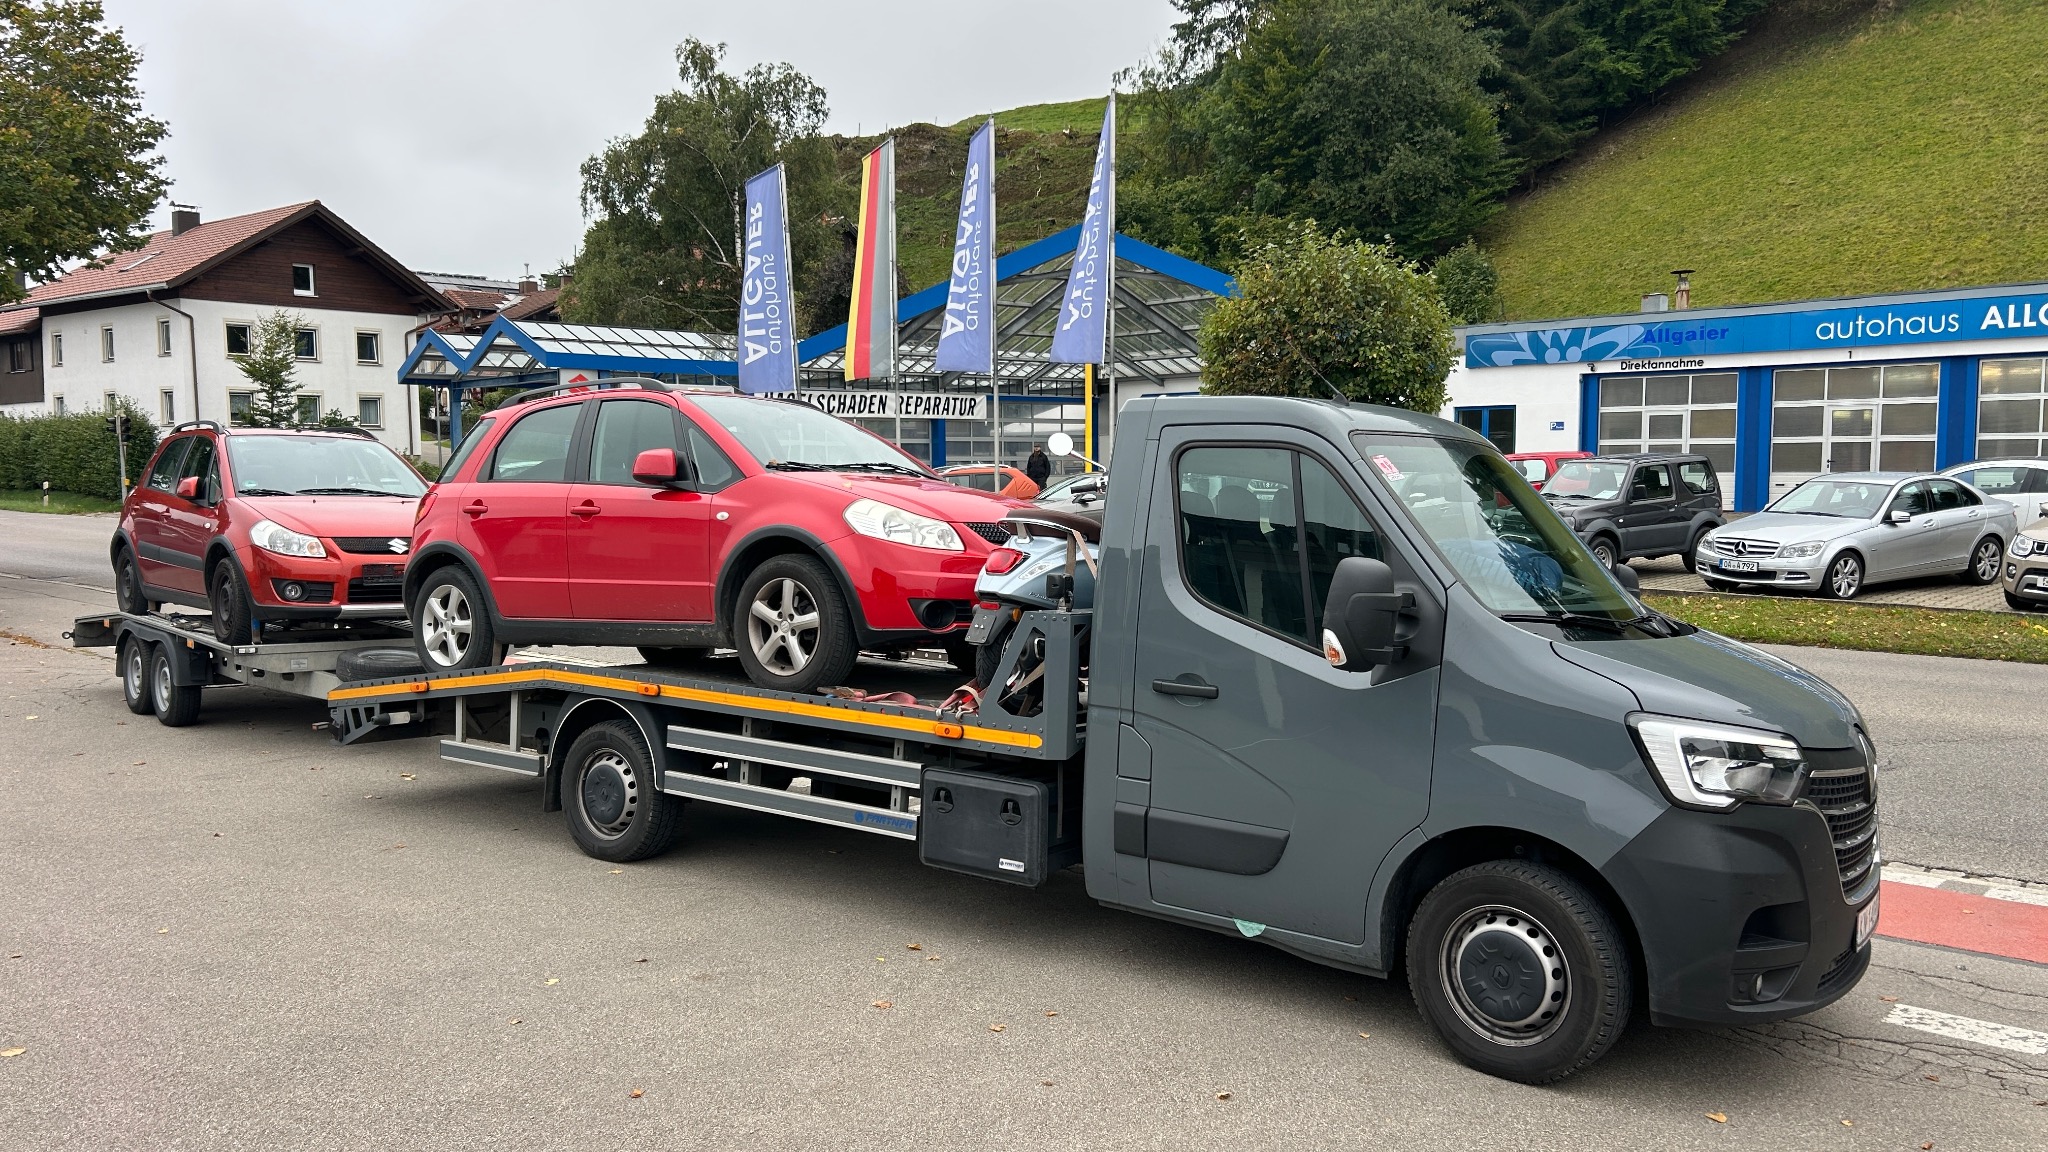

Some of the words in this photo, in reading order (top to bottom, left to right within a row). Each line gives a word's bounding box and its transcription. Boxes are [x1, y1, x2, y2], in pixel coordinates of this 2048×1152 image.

[1642, 326, 1729, 346] Allgaier
[1816, 313, 1960, 340] autohaus
[1620, 359, 1704, 370] Direktannahme
